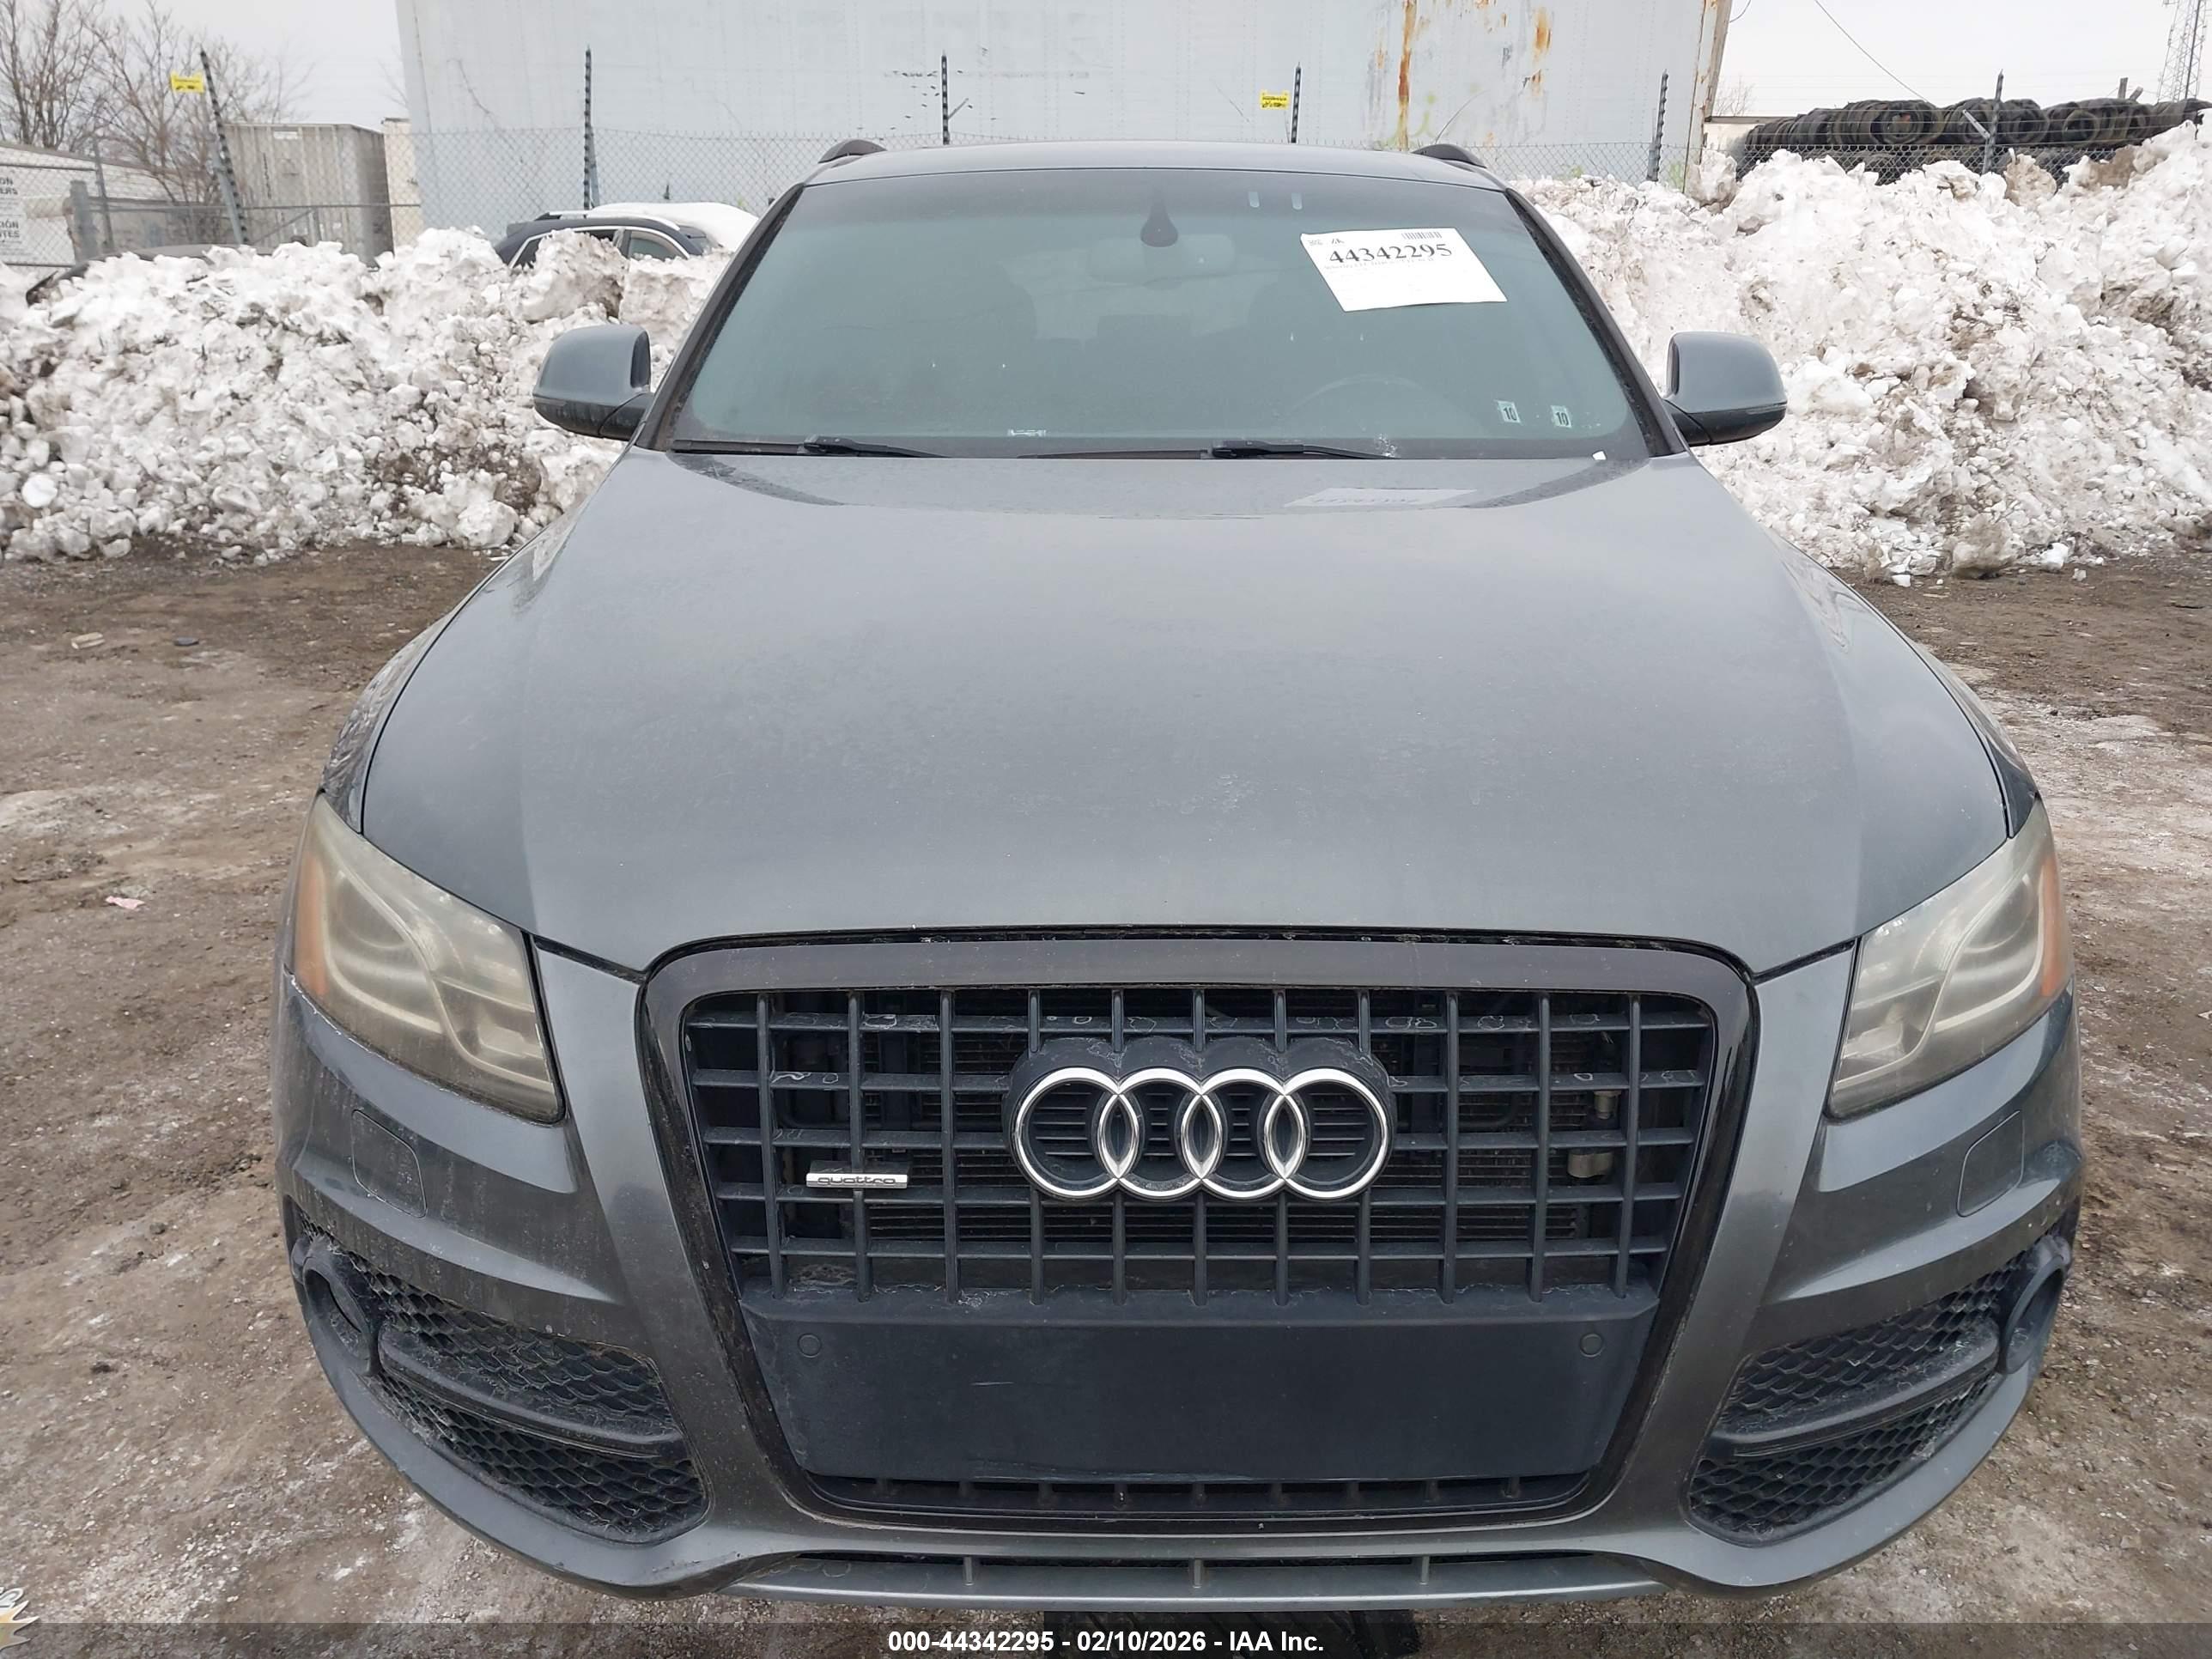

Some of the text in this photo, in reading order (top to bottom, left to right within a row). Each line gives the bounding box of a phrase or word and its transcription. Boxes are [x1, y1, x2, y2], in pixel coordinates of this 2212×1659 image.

[1329, 243, 1452, 263] 44342295
[1503, 407, 1517, 421] 10
[1556, 411, 1569, 426] 10
[817, 1176, 896, 1185] quattro
